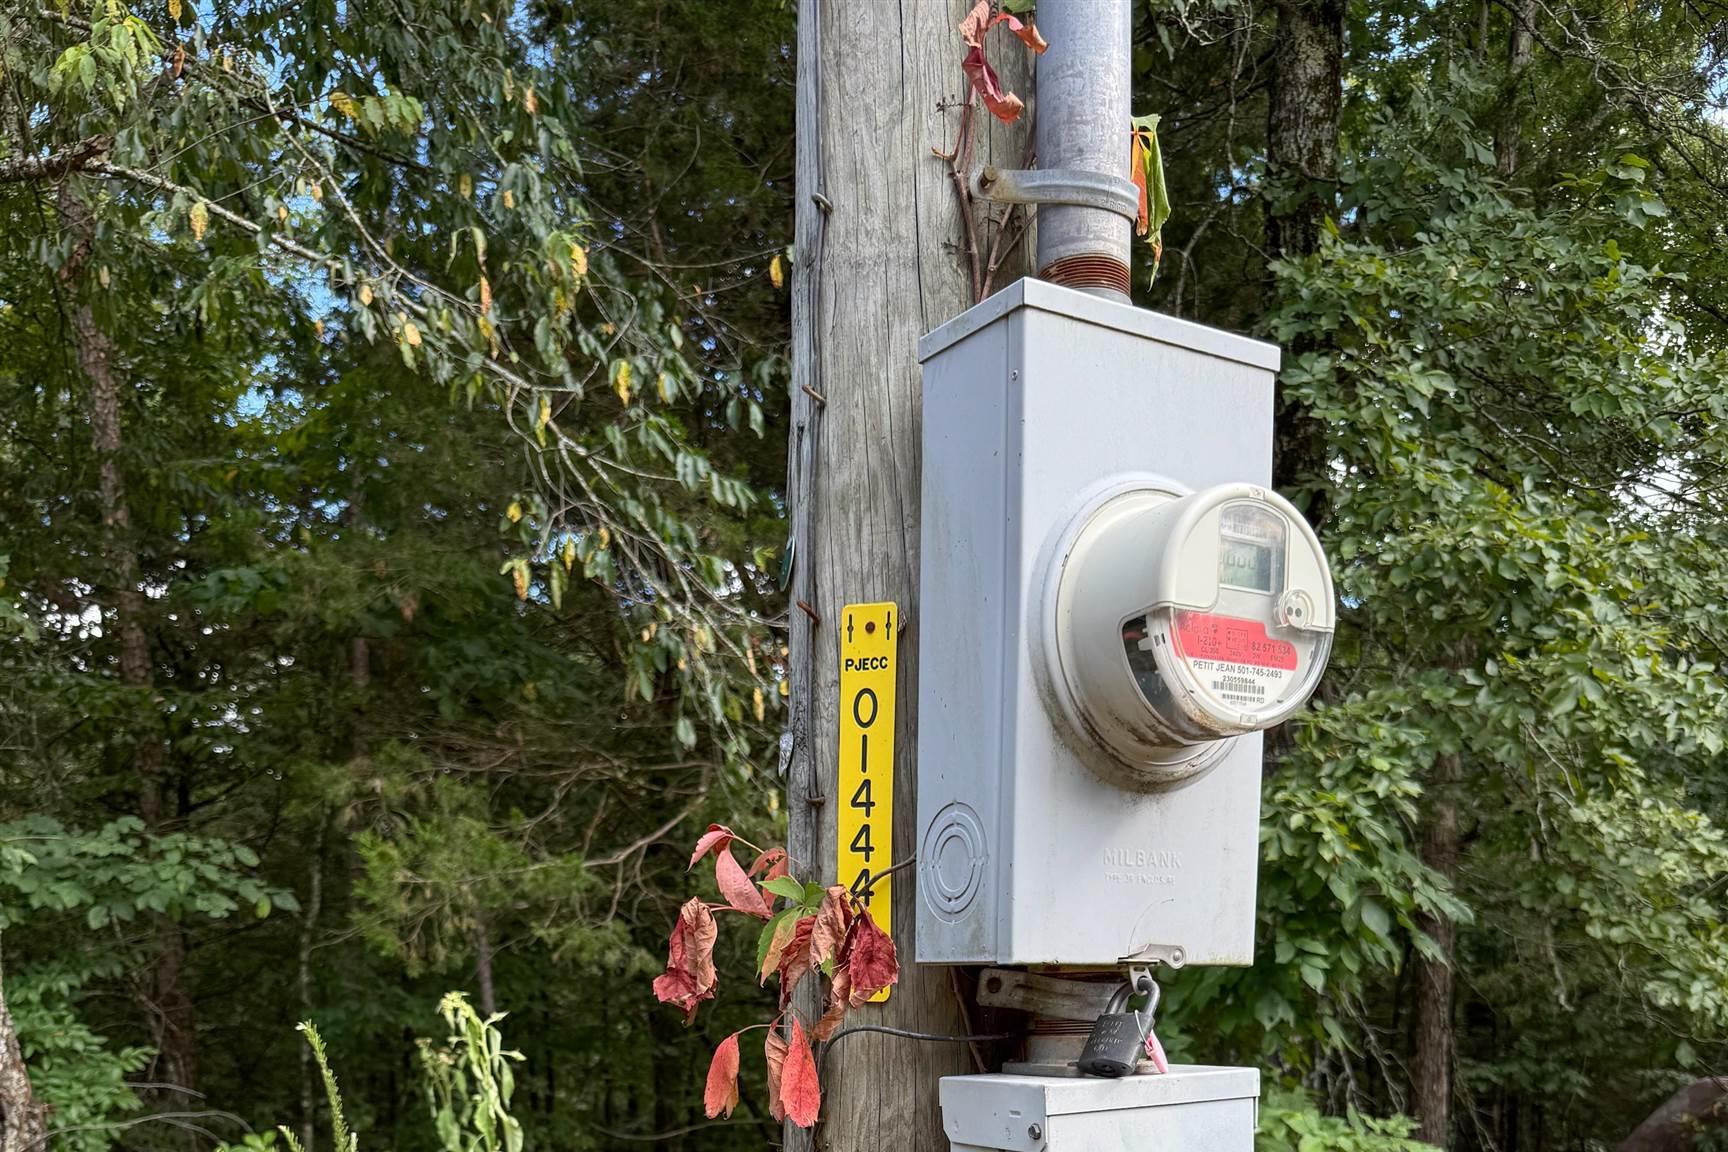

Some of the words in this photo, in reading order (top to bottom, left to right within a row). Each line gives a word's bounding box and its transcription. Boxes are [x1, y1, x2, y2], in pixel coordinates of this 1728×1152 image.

[845, 656, 889, 672] PJECC
[1193, 660, 1214, 671] PETIT
[1216, 663, 1235, 673] JEAN
[1103, 848, 1182, 869] MILBANK
